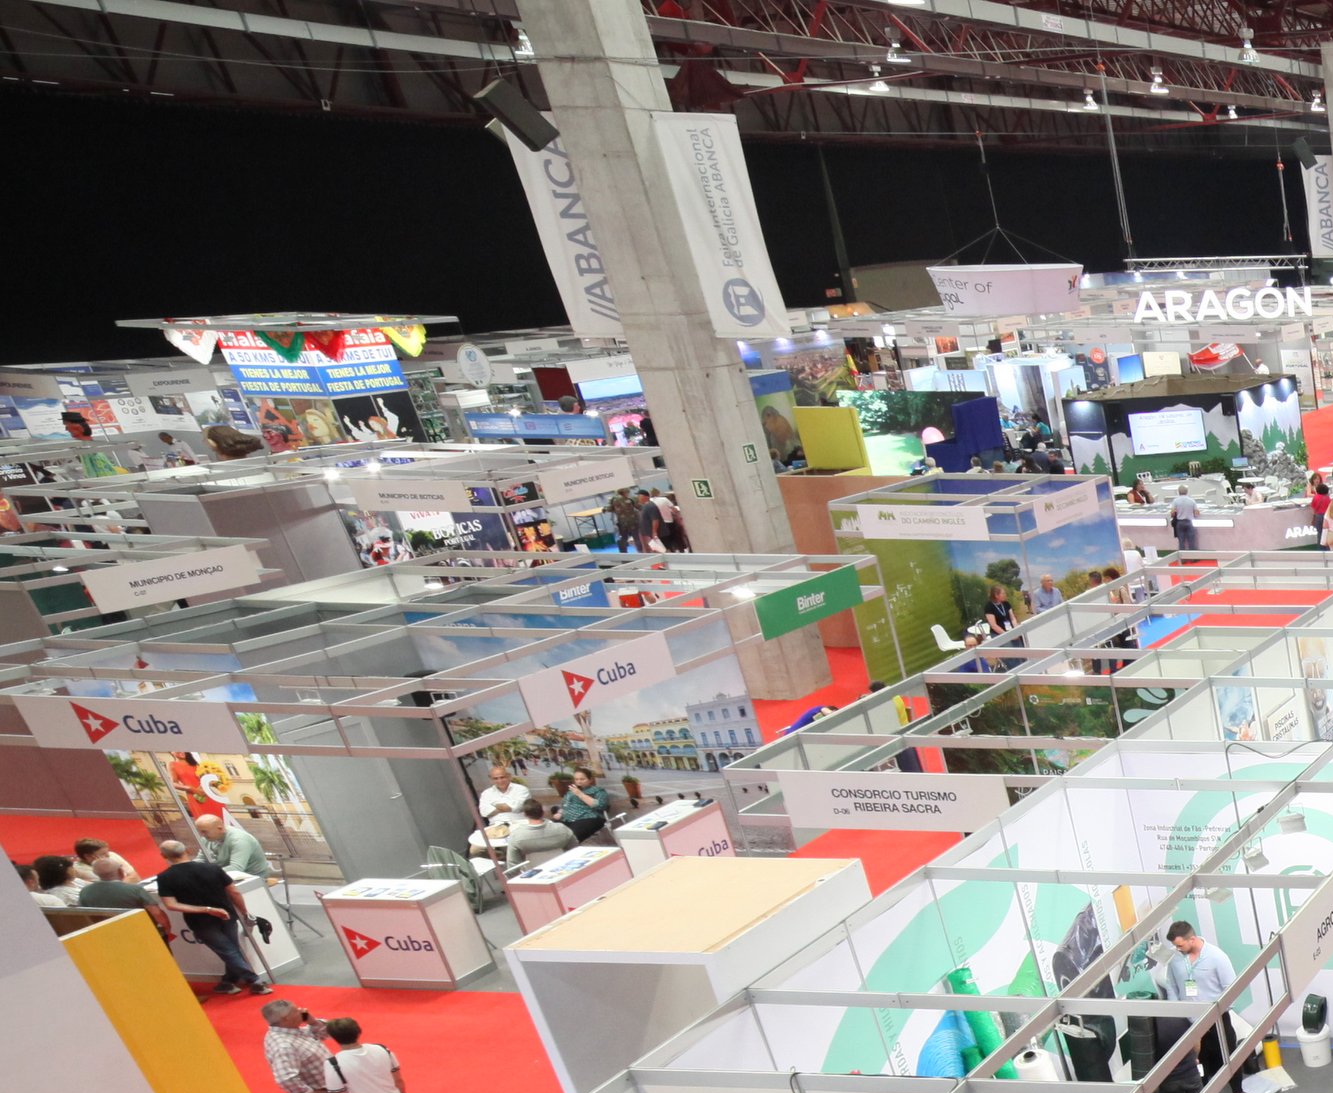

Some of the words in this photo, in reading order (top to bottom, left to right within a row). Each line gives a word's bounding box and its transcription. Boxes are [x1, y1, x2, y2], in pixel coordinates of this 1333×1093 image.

[700, 127, 726, 193] ABANCA
[721, 197, 741, 248] Galicia
[1134, 279, 1312, 323] ARAGÓN
[239, 368, 269, 379] TIENES
[270, 368, 282, 379] LA
[282, 368, 310, 380] MEJOR
[326, 367, 355, 379] TIENES
[355, 366, 365, 378] LA
[366, 364, 393, 376] MEJOR
[240, 381, 267, 392] FIESTA
[269, 382, 281, 392] DE
[281, 382, 324, 393] PORTUGAL
[326, 380, 354, 393] FIESTA
[354, 379, 366, 391] DE
[366, 376, 404, 390] PORTUGAL
[1285, 525, 1316, 538] ARAG
[129, 575, 174, 588] MUNICIPIO
[174, 571, 187, 581] DE
[560, 582, 592, 600] Binter
[797, 591, 826, 612] Binter
[597, 660, 637, 687] Cuba
[122, 714, 183, 735] Cuba
[831, 787, 902, 801] CONSORCIO
[903, 789, 957, 802] TURISMO
[854, 801, 900, 813] RIBEIRA
[902, 803, 942, 815] SACRA
[384, 935, 434, 953] Cuba
